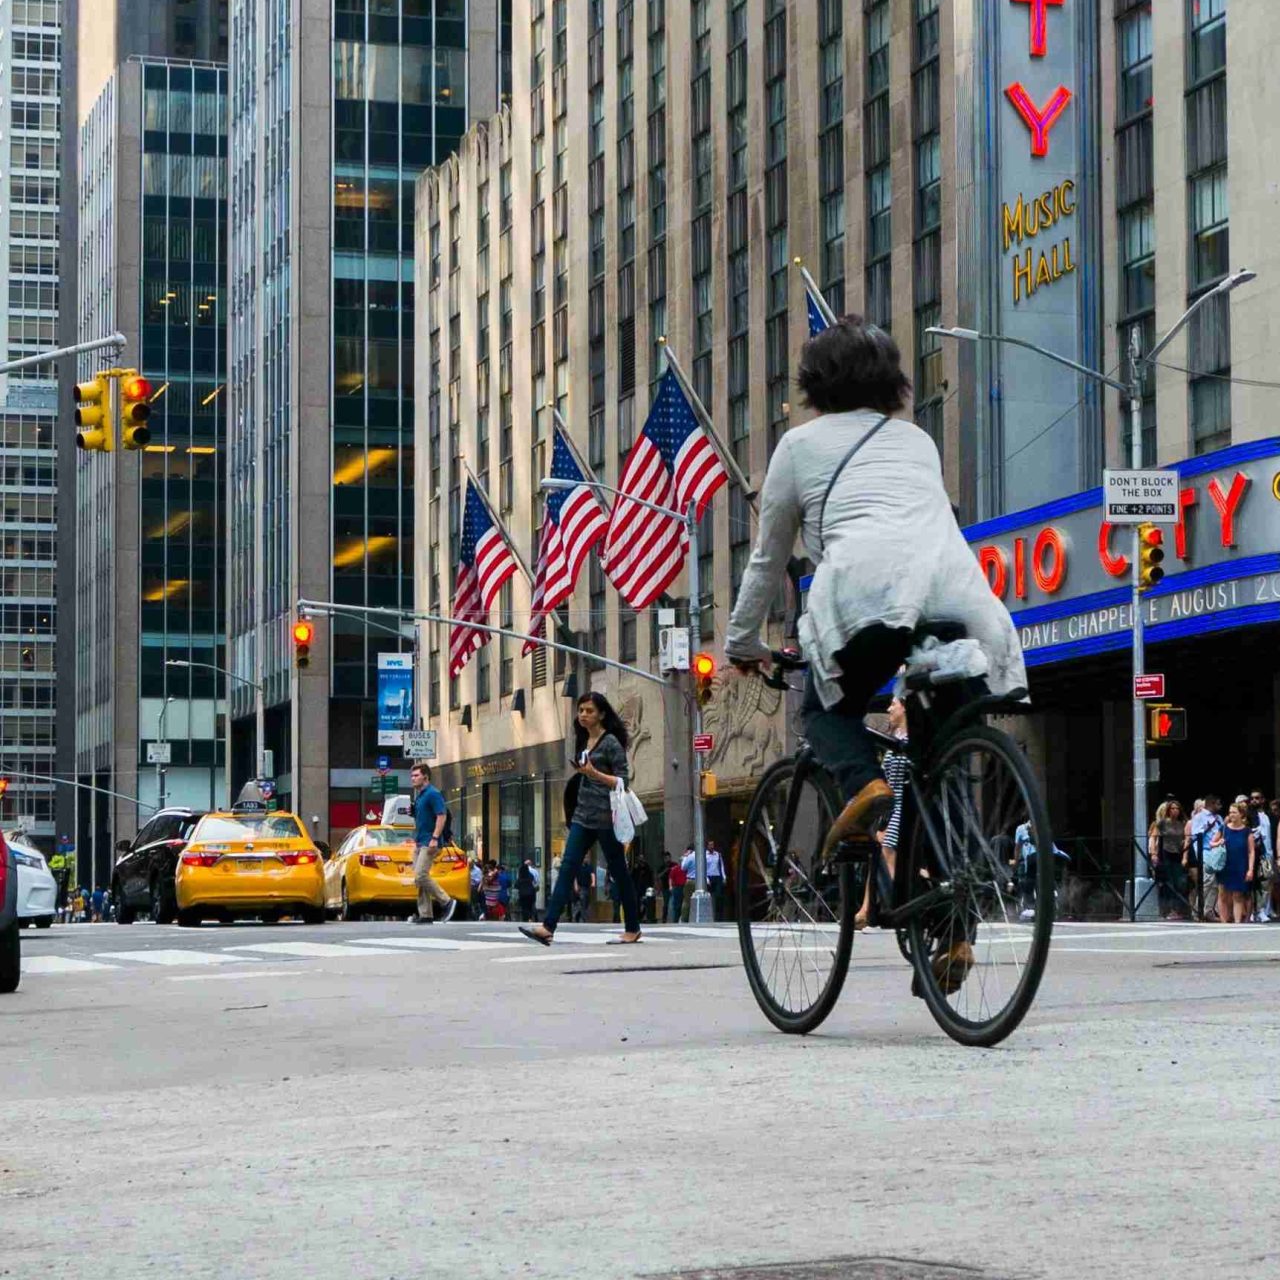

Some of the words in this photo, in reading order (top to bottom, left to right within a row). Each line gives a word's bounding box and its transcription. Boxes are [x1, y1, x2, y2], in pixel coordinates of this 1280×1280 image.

[1003, 180, 1075, 248] MUSIC
[1014, 238, 1076, 304] HALL
[1111, 505, 1129, 514] FINE
[1146, 505, 1173, 514] POINTS
[1122, 488, 1140, 497] THE
[1143, 488, 1162, 497] BOX
[1141, 477, 1173, 486] BLOCK
[979, 526, 1066, 598] DIO
[1098, 471, 1250, 577] CTY
[1022, 620, 1060, 649] DAVE
[1068, 598, 1158, 639] CHAPPELE
[1170, 580, 1239, 618] AUGUST
